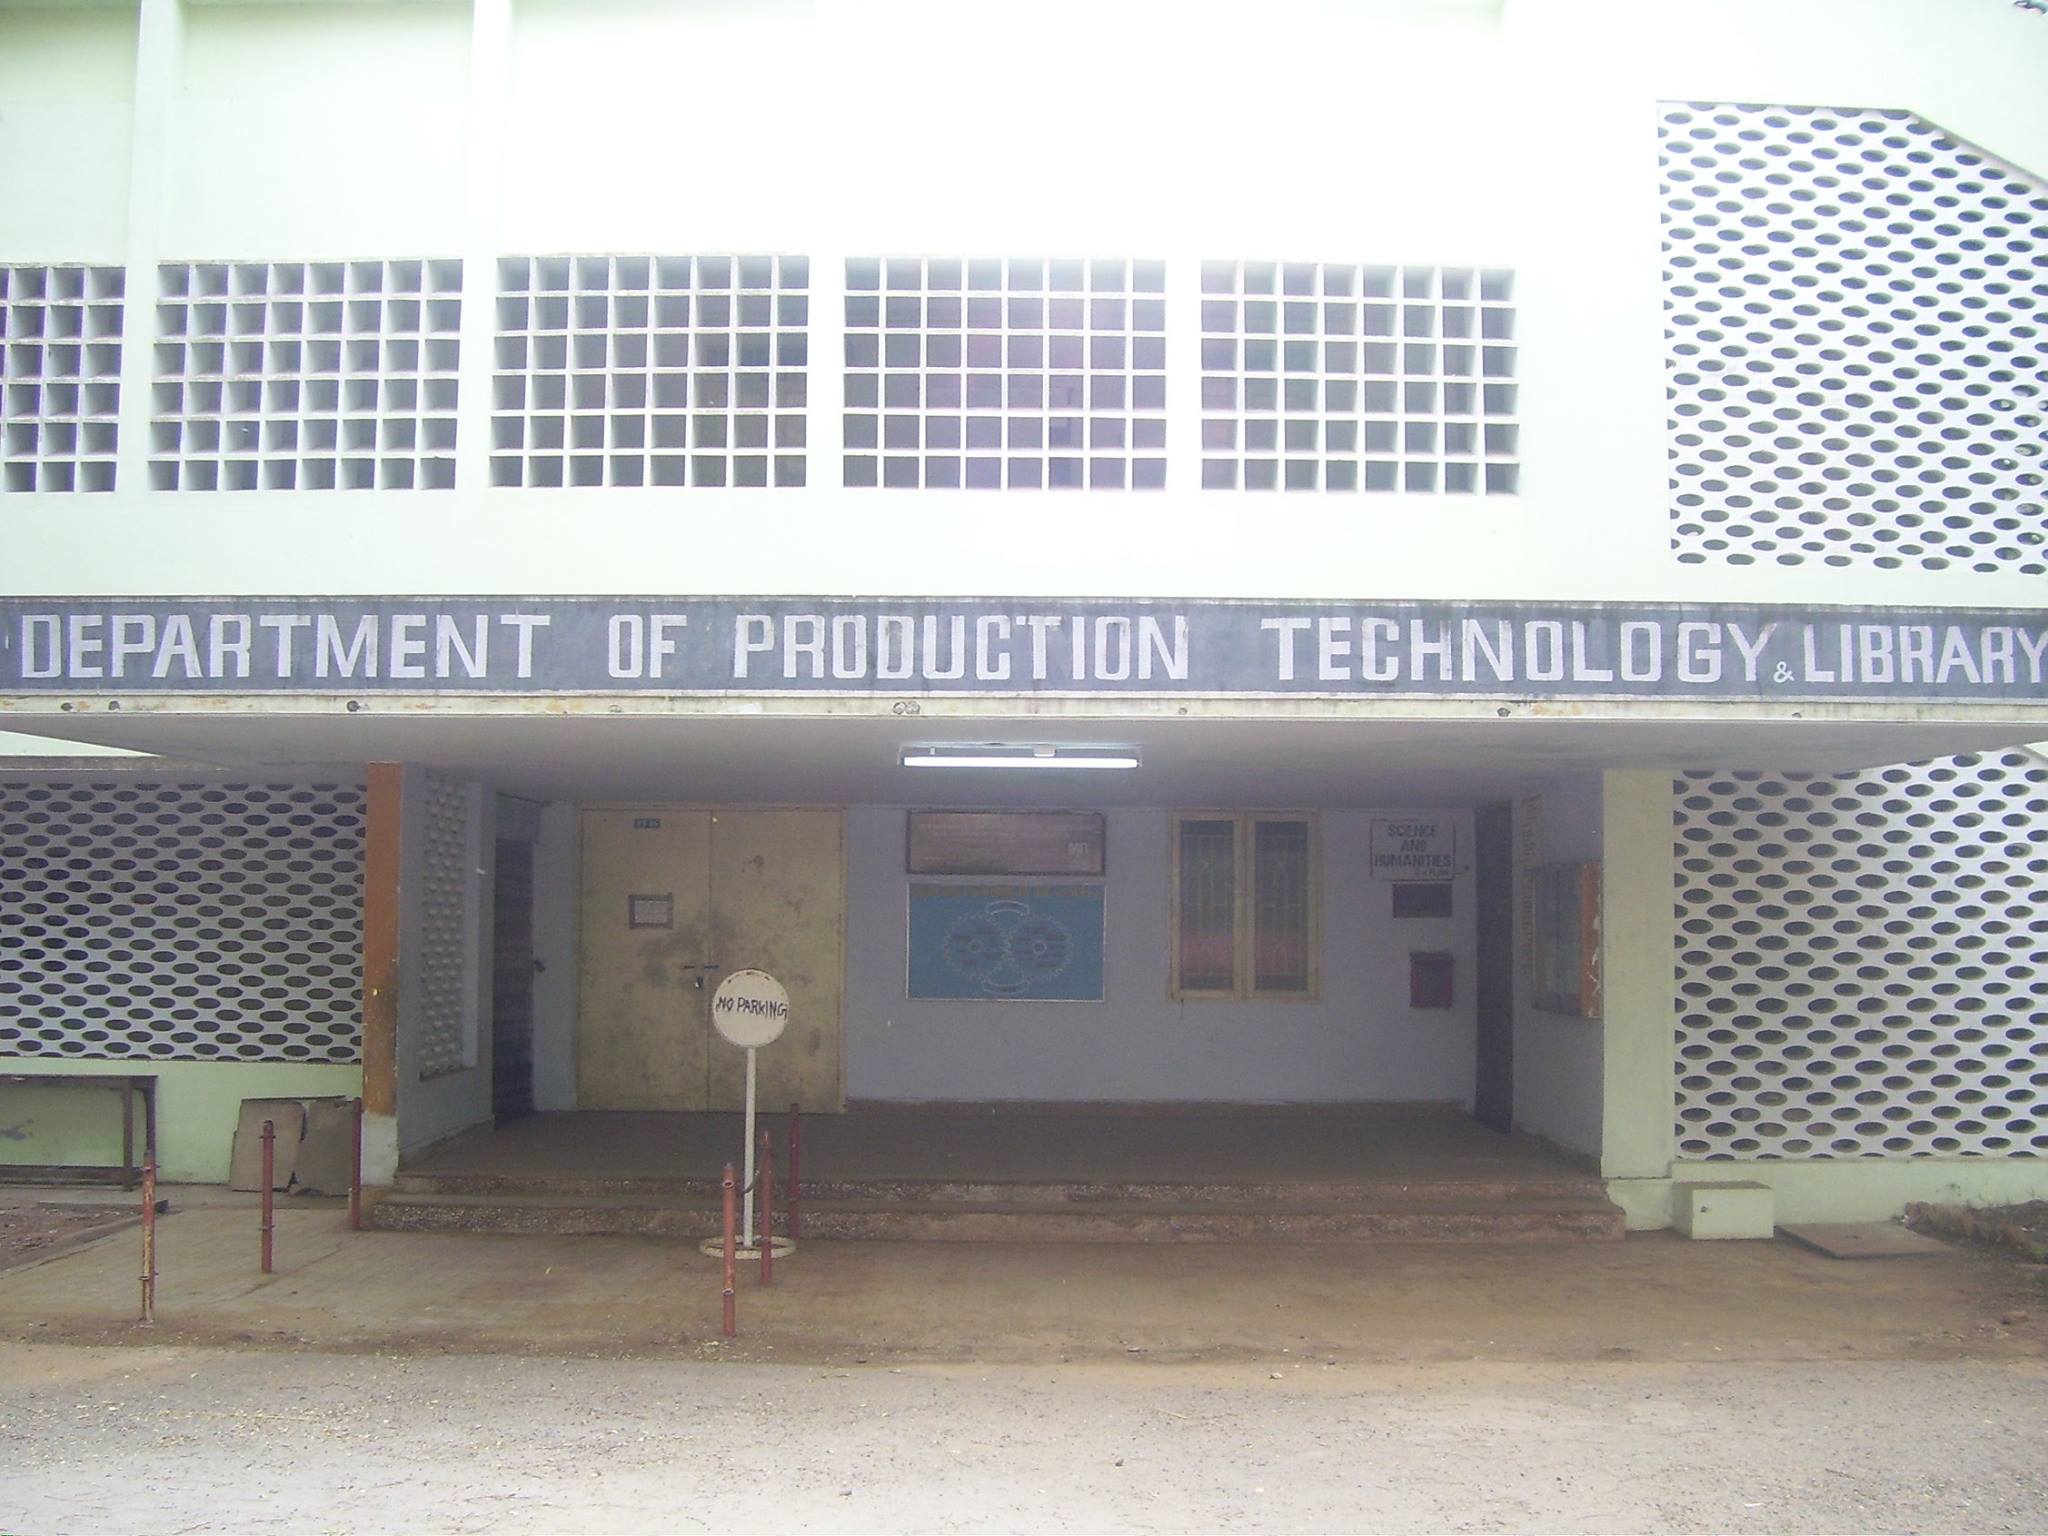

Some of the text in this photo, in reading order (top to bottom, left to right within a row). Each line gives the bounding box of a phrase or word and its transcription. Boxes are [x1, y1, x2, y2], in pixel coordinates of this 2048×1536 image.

[21, 613, 2048, 685] DEPARTMENT OF PRODUCTION TECHNOLOGY & LIBRARY
[1400, 838, 1427, 853] AND
[1374, 853, 1452, 868] HUMANITIES
[715, 996, 788, 1021] NO PARKING
